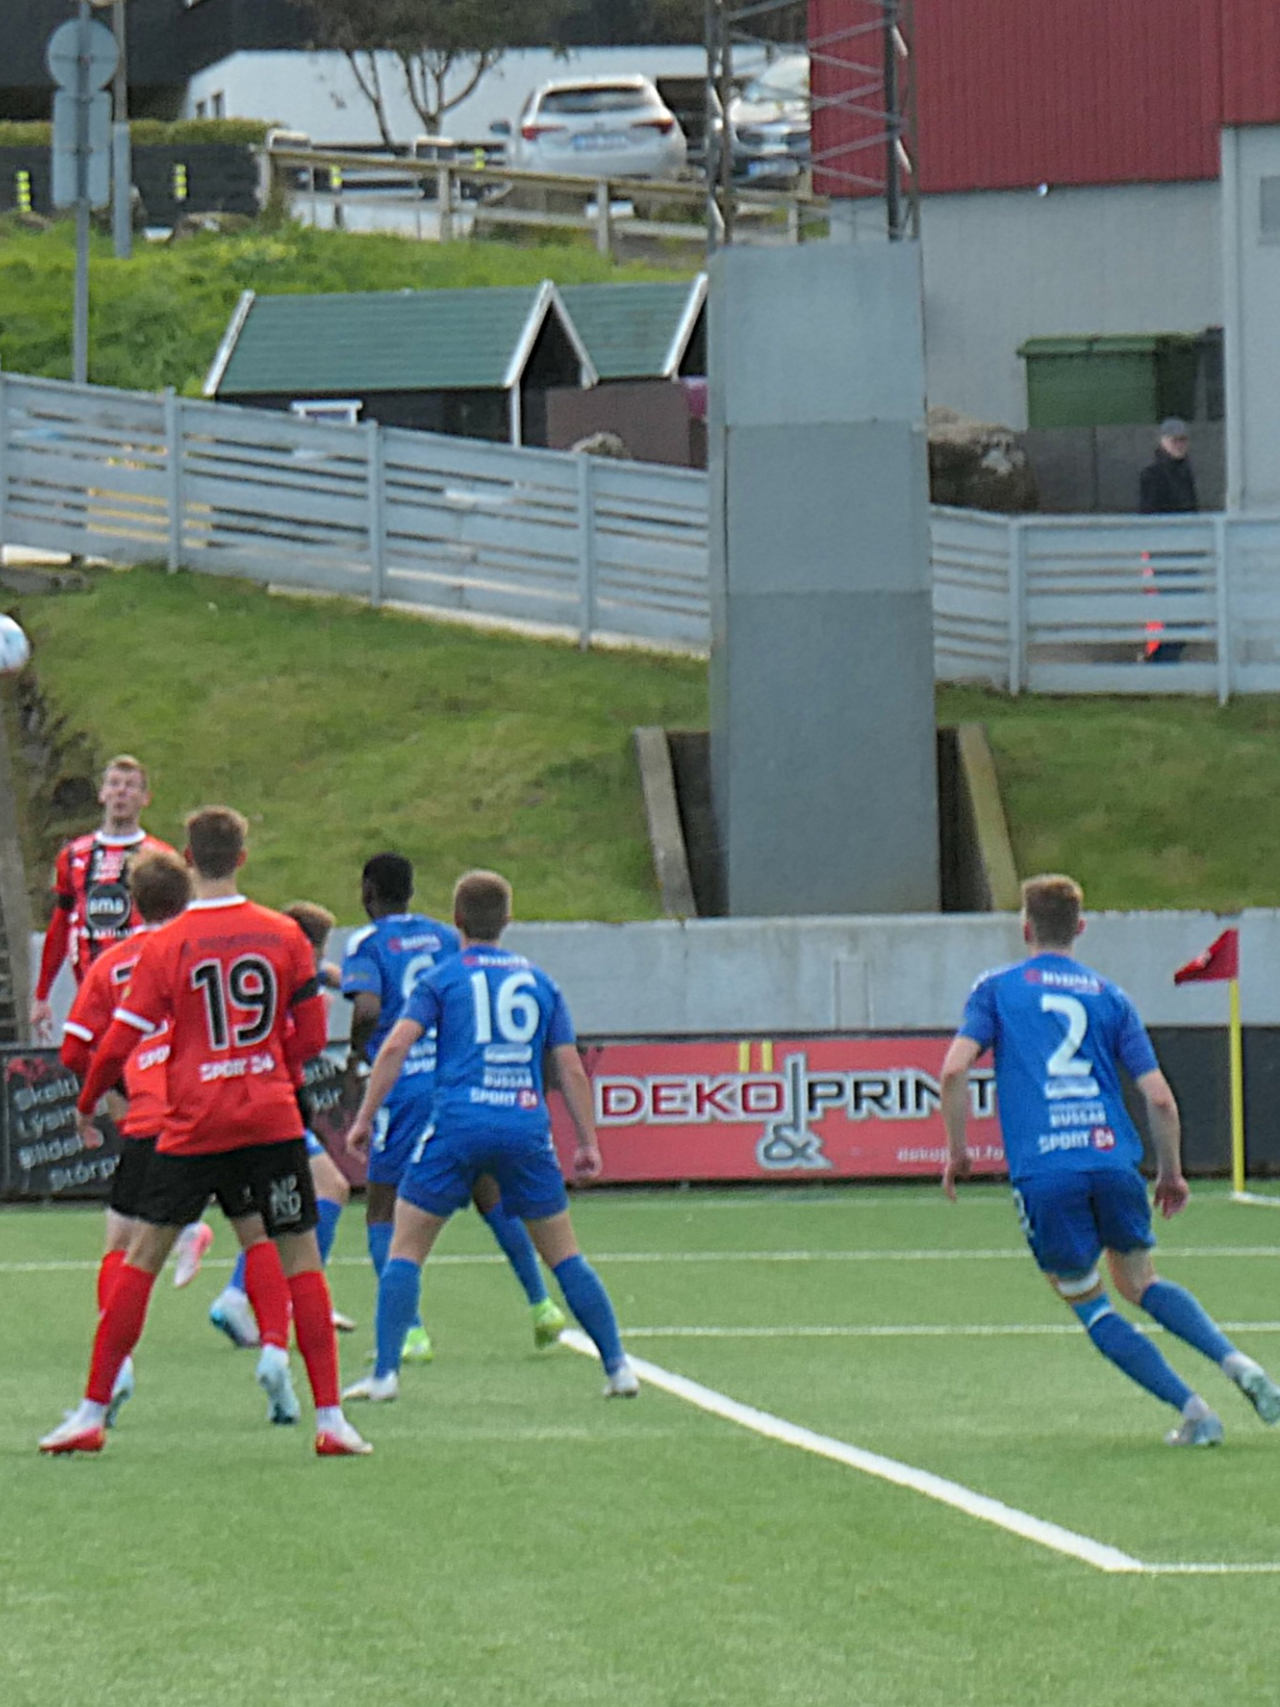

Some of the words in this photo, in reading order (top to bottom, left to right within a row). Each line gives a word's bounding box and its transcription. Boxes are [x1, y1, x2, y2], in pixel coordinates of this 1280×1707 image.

[190, 952, 277, 1051] 19
[471, 970, 540, 1044] 16
[1041, 993, 1093, 1076] 2
[595, 1075, 788, 1124] DEKO
[1038, 1131, 1091, 1154] SPORT
